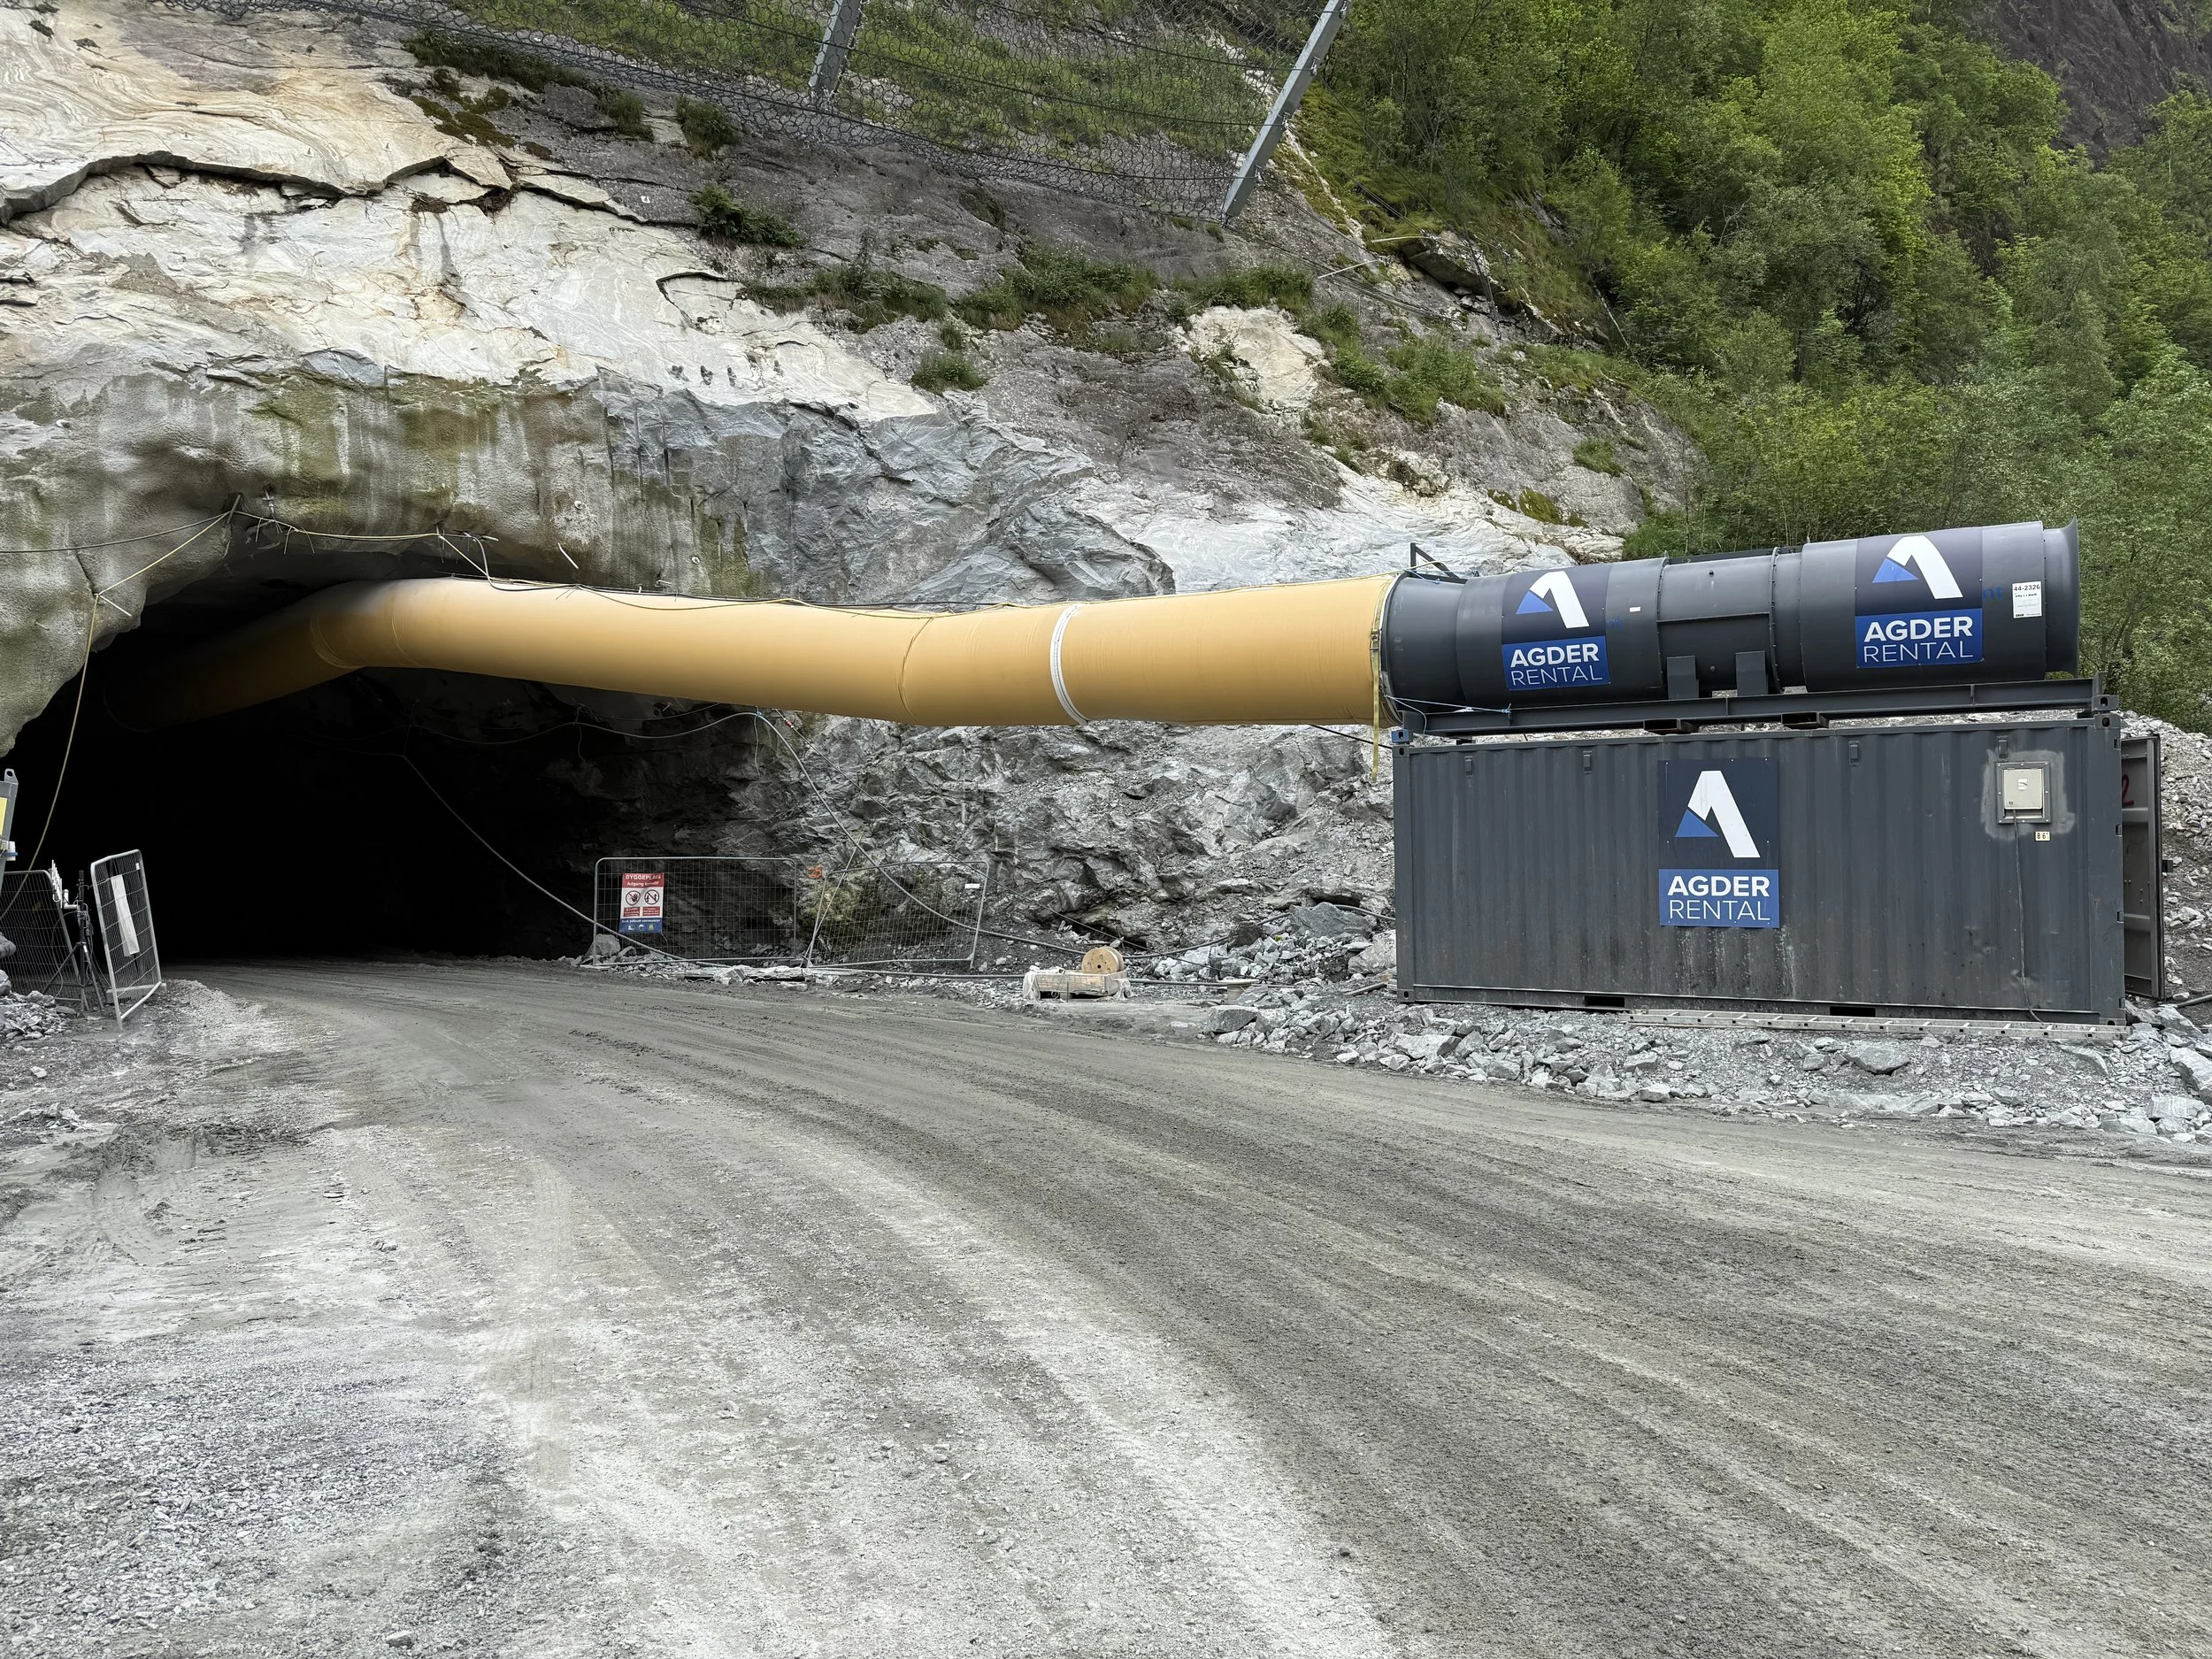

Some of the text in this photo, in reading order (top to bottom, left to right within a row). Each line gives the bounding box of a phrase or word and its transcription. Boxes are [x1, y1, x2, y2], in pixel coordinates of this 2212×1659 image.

[1863, 616, 1973, 642] AGDER
[1510, 643, 1600, 668] AGDER
[1863, 641, 1974, 663] RENTAL
[1511, 664, 1602, 686] RENTAL
[1667, 876, 1770, 897] AGDER
[1669, 900, 1770, 921] RENTAL
